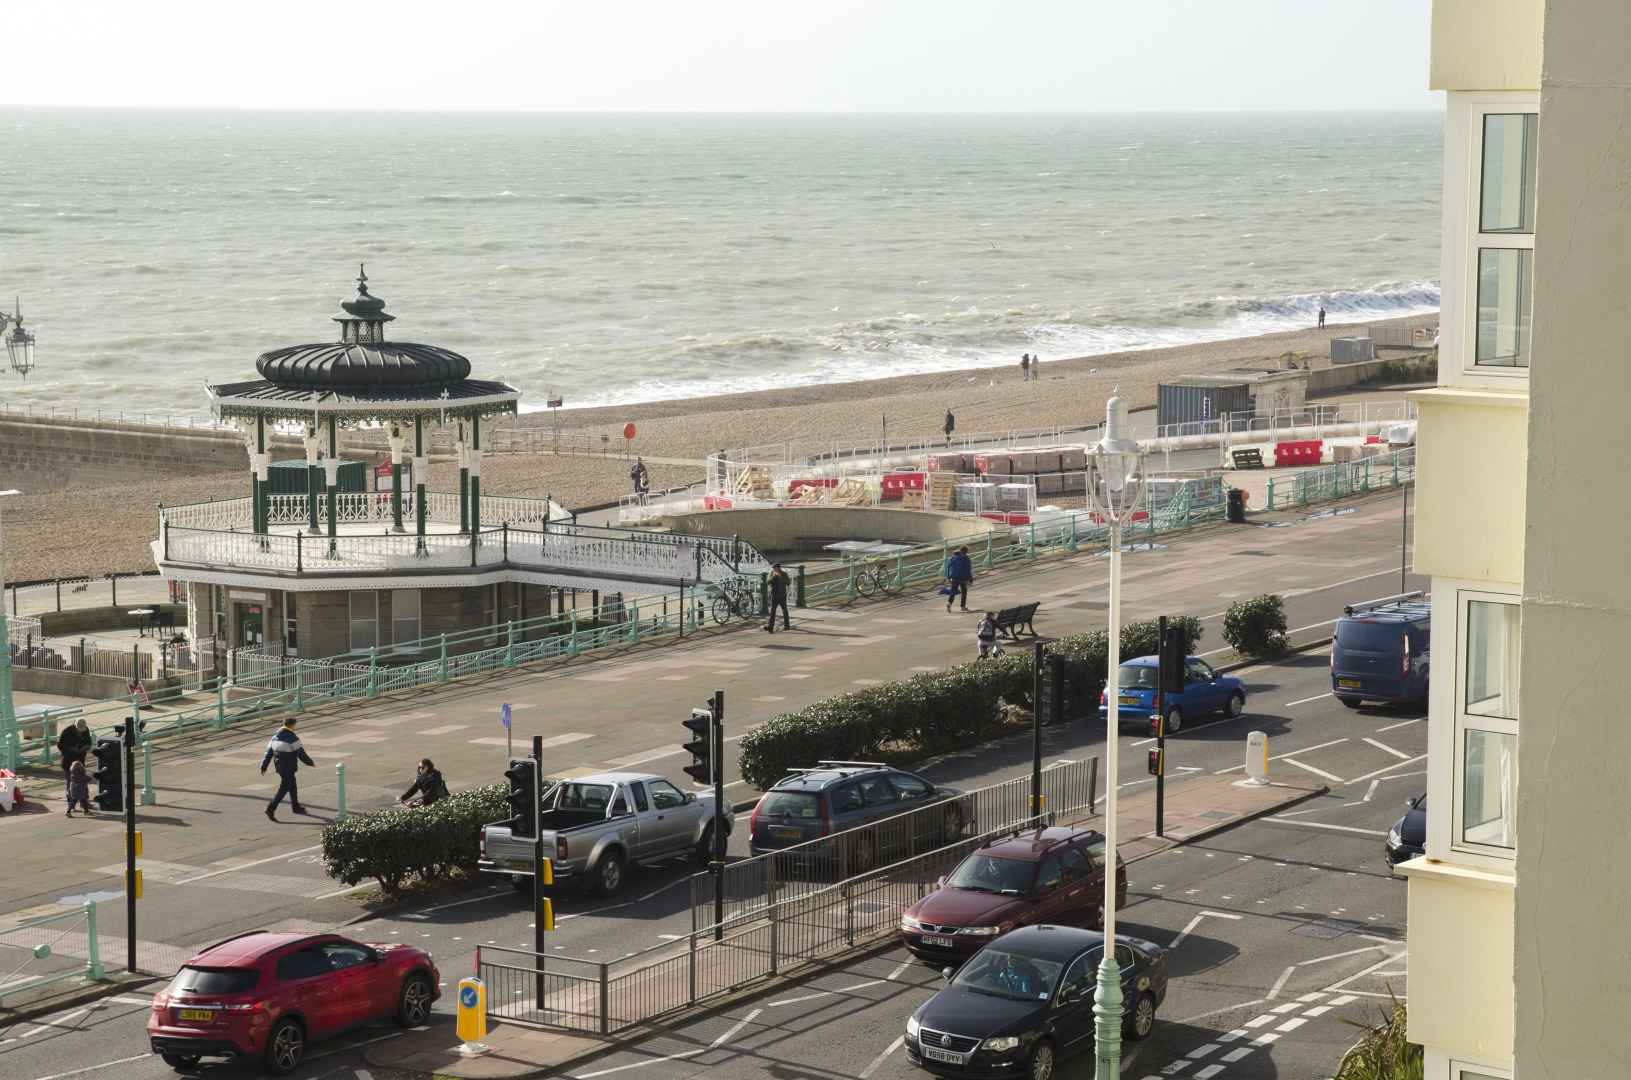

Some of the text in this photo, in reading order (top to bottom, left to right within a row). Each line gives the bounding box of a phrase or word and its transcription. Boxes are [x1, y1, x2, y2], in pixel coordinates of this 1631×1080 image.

[181, 1009, 210, 1020] LS65 VWA
[946, 1053, 960, 1063] DYY
